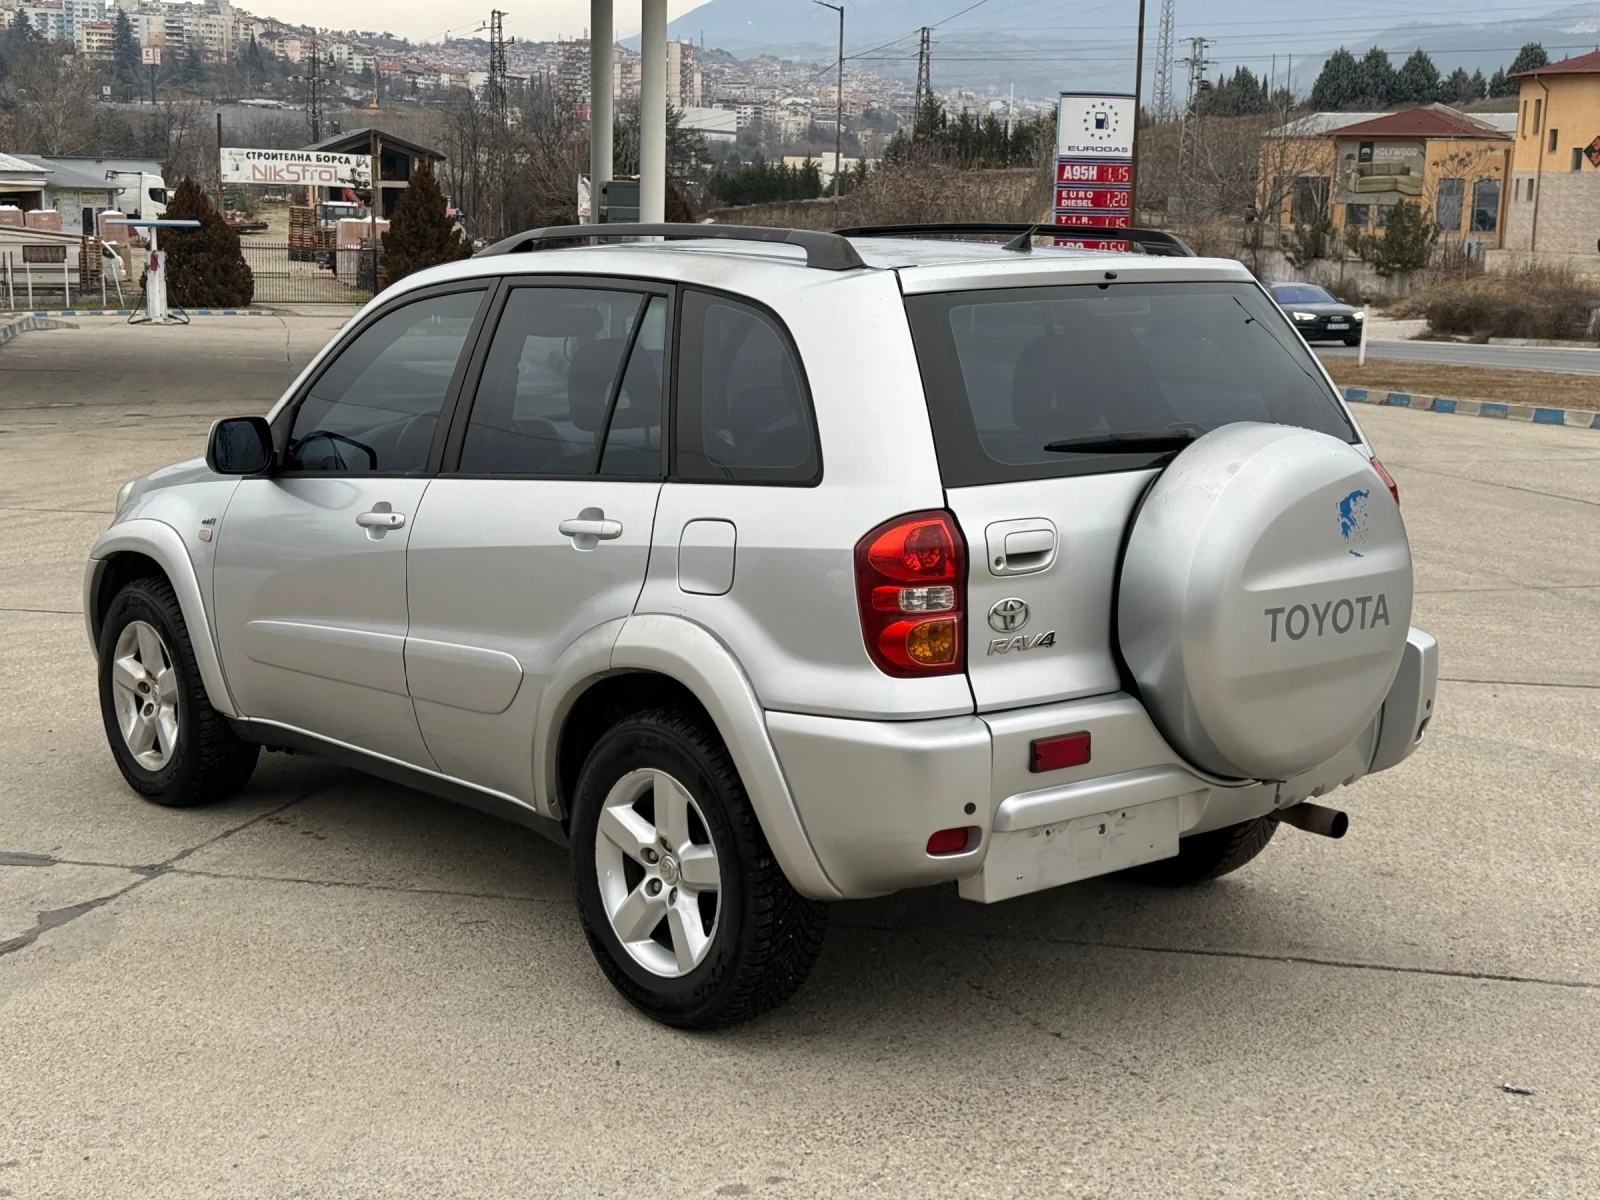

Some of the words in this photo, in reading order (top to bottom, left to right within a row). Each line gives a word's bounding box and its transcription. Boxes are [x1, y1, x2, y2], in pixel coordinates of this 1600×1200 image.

[1067, 145, 1129, 153] EUROGAS
[1374, 147, 1418, 157] HOLYWOOD
[246, 151, 312, 162] СТРОИТЕЛНА
[316, 154, 351, 165] БОРСА
[1063, 165, 1098, 180] A95H
[1061, 190, 1094, 198] EURO
[1061, 199, 1093, 207] DIESEL
[1060, 216, 1093, 225] T.I.R.
[1264, 593, 1390, 643] TOYOTA
[986, 630, 1057, 656] RAV4
